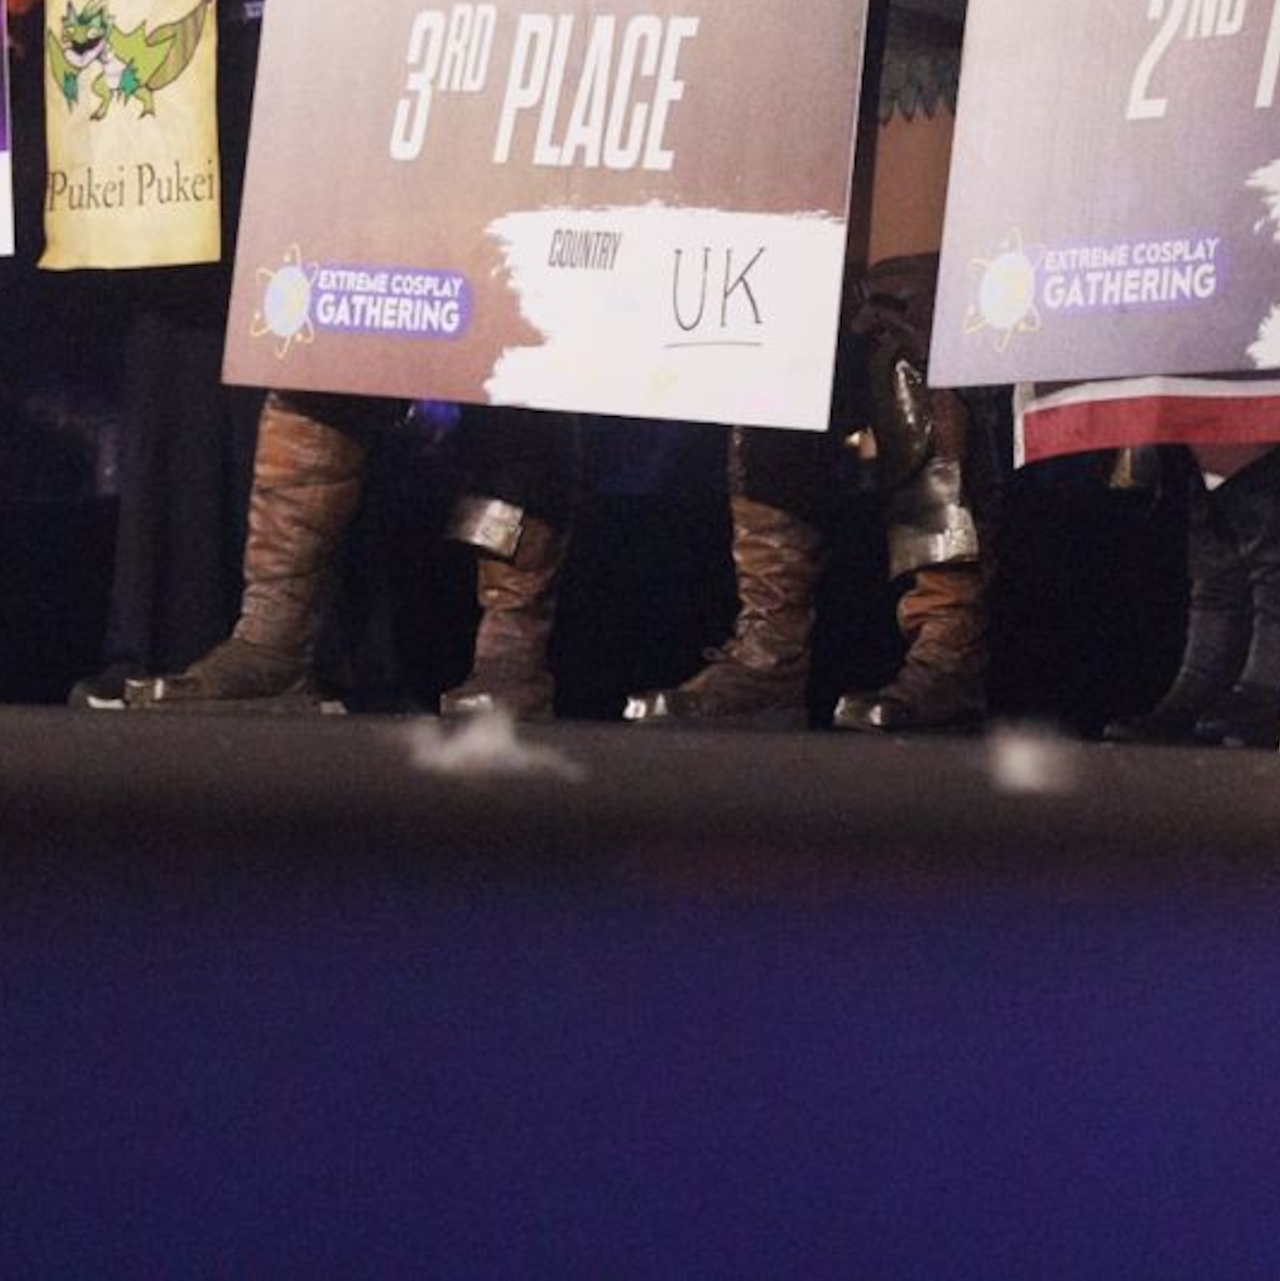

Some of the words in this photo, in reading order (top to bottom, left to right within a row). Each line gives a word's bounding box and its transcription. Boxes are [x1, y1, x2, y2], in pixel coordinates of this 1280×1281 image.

[389, 2, 498, 161] 3RD
[492, 13, 700, 171] PLACE
[45, 165, 125, 212] Pukei
[136, 158, 215, 207] Pukei
[547, 228, 623, 271] COUNTRY
[1043, 243, 1130, 271] EXTREME
[1131, 236, 1220, 263] COSPLAY
[316, 269, 389, 295] EXTREME
[389, 273, 464, 299] COSPLAY
[671, 246, 766, 332] UK
[1042, 263, 1217, 309] GATHERING
[315, 293, 462, 334] GATHERING
